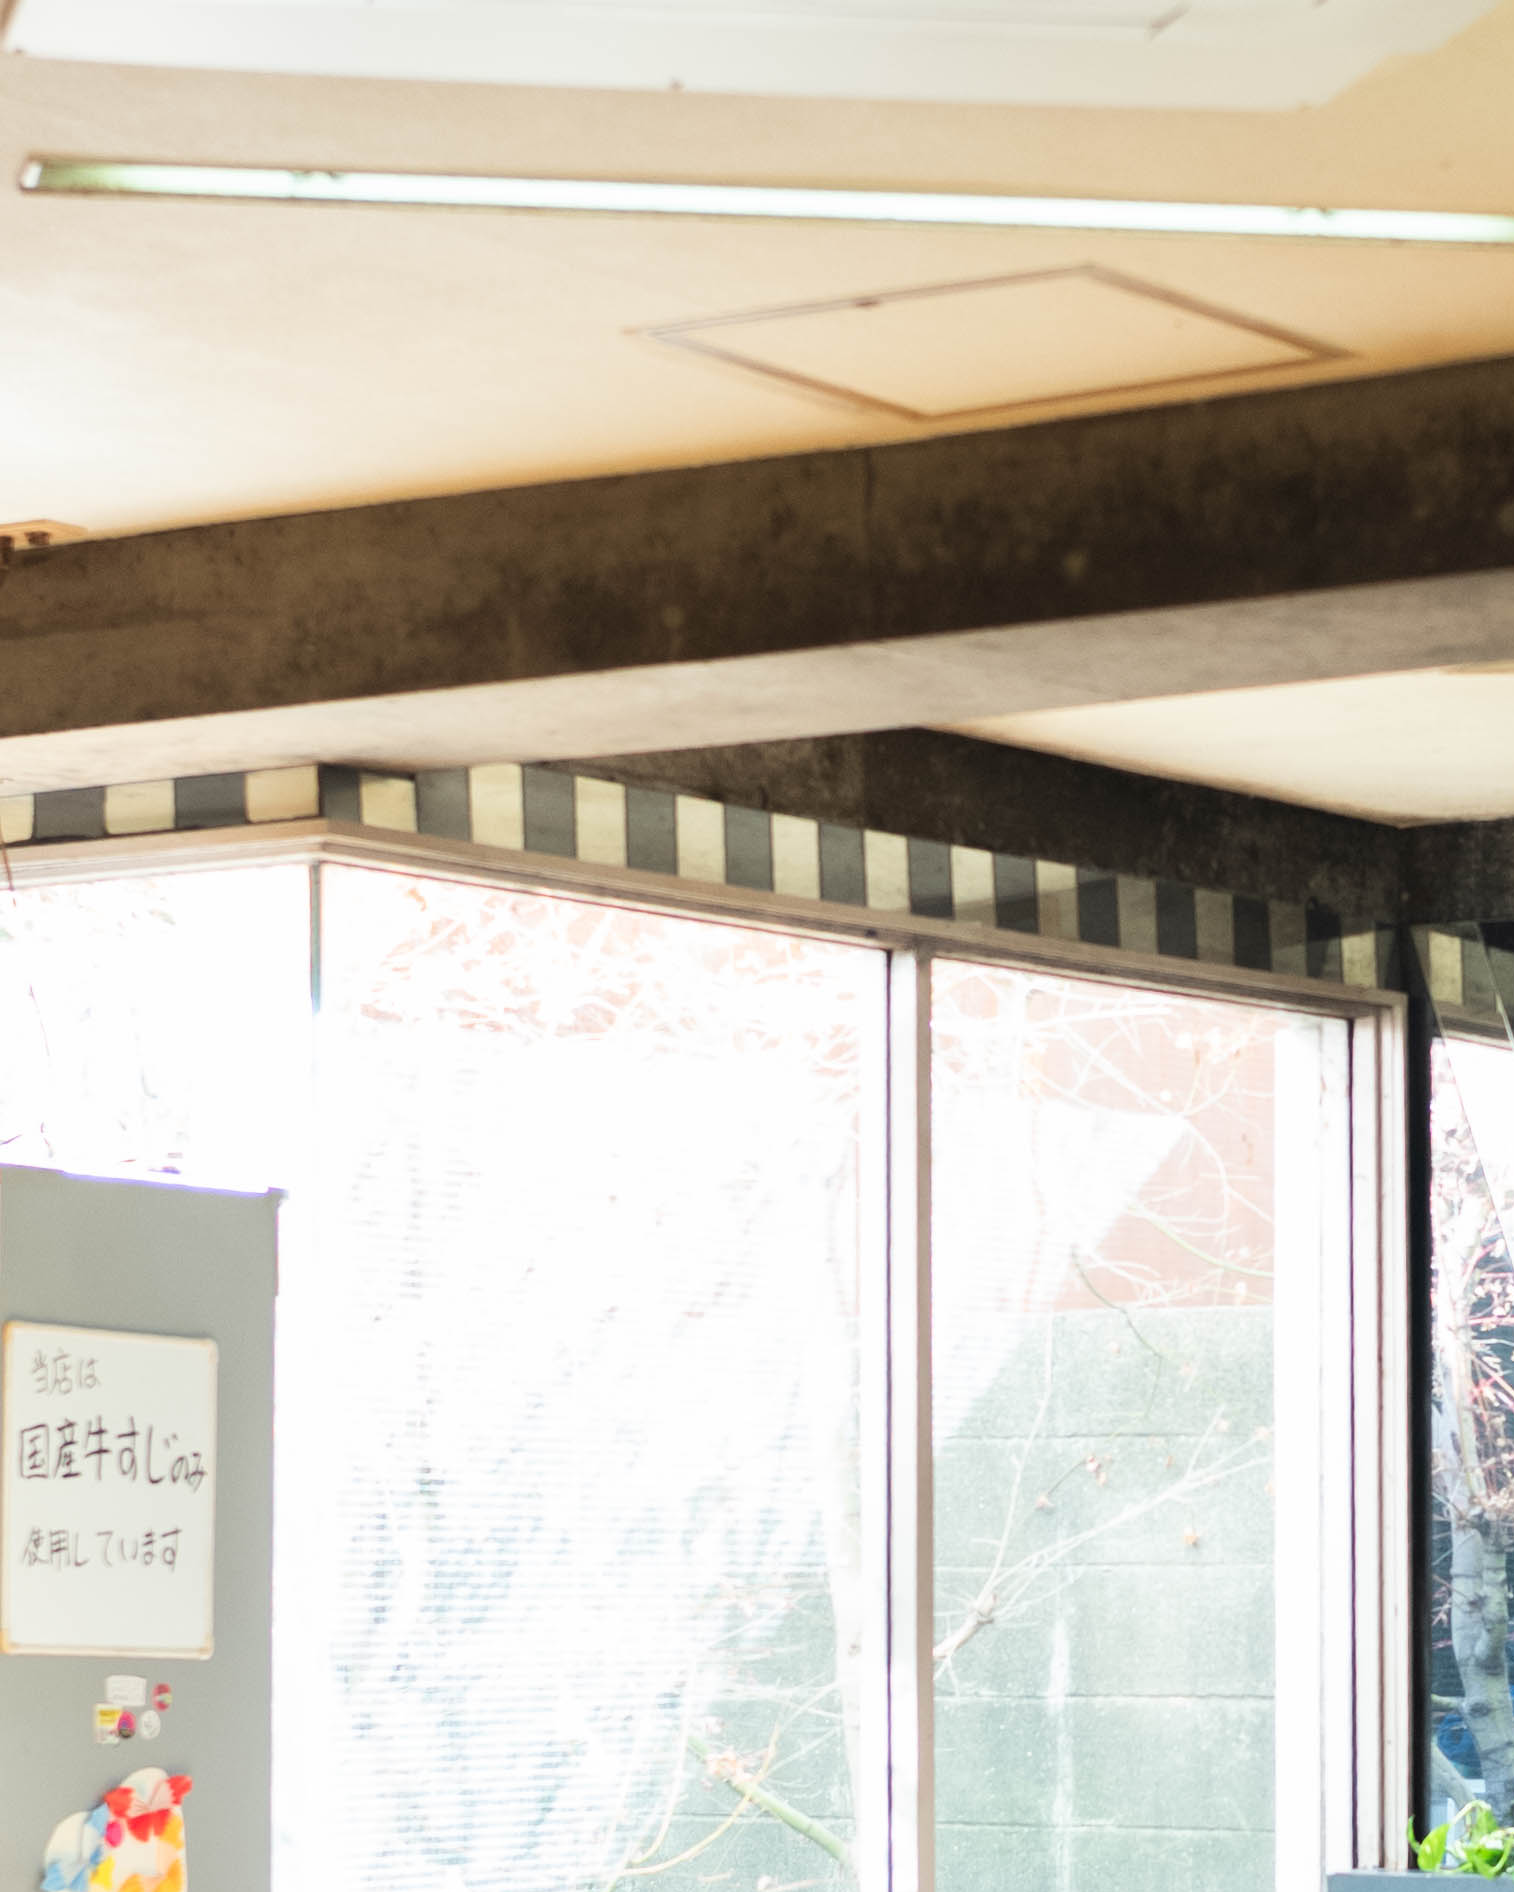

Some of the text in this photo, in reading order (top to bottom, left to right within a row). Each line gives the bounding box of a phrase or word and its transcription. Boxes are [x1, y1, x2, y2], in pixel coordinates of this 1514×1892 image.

[32, 1349, 101, 1395] 当店は
[19, 1415, 208, 1493] 国産牛すじのみ
[23, 1526, 183, 1573] 使用しています
